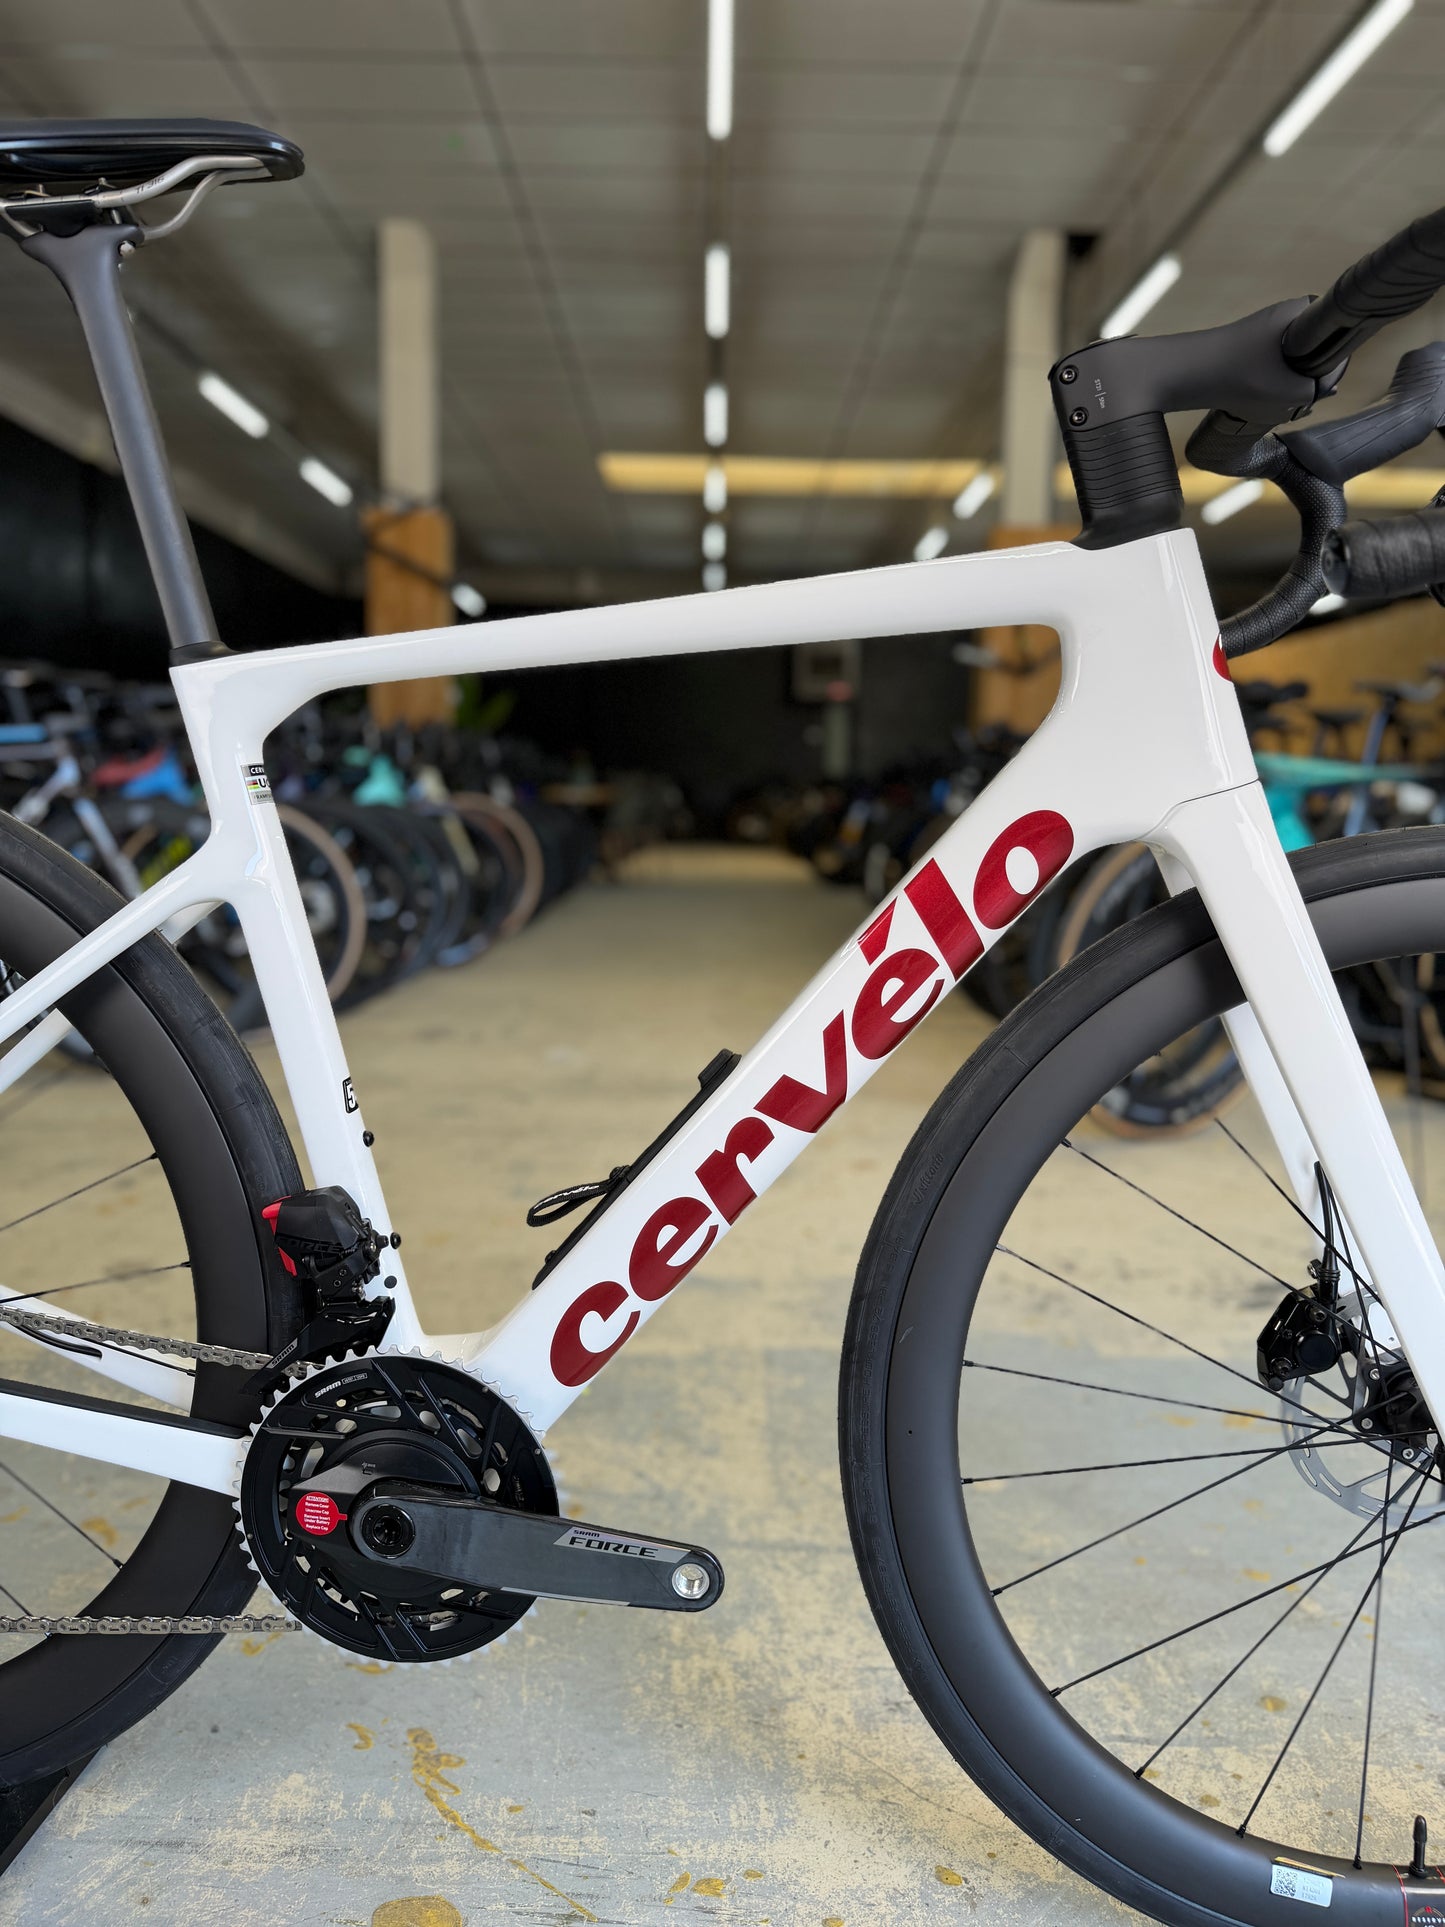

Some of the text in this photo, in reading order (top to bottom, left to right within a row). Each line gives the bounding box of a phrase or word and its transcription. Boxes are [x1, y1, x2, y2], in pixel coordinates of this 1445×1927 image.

[549, 809, 1075, 1388] cervélo
[314, 1380, 342, 1399] SRAM
[573, 1529, 600, 1538] SRAM
[568, 1536, 659, 1558] FORCE
